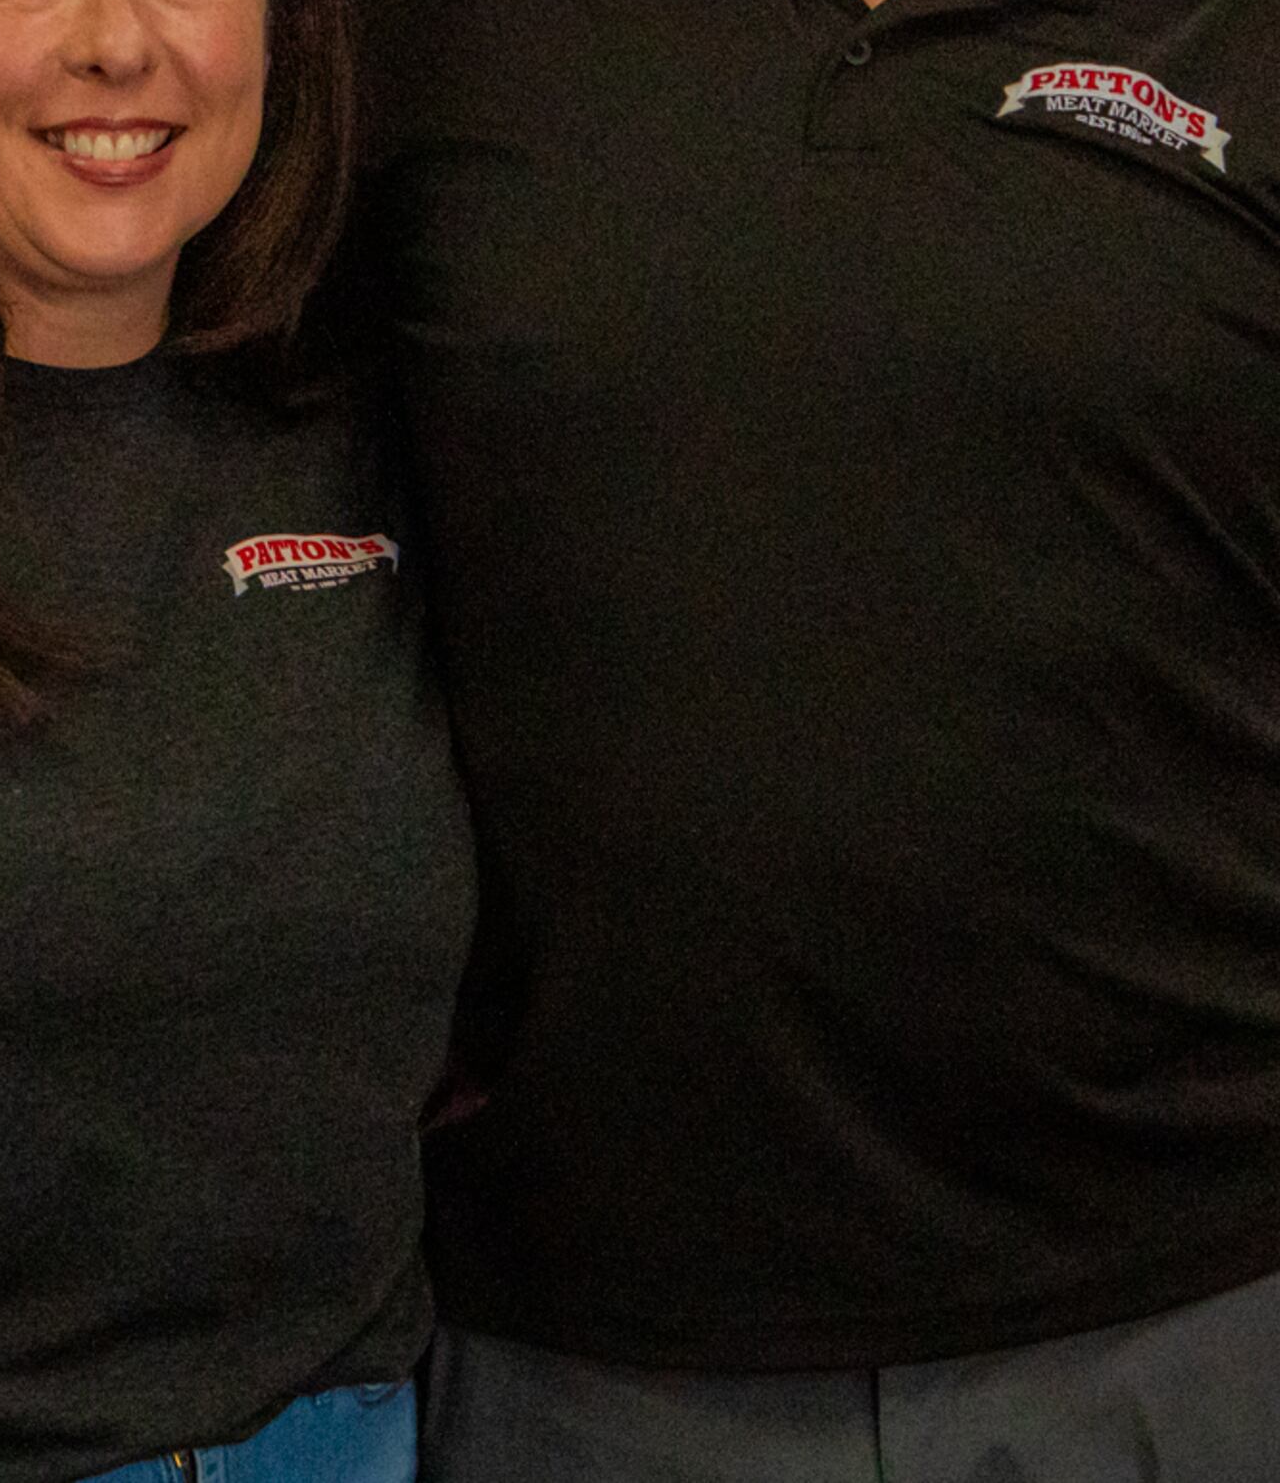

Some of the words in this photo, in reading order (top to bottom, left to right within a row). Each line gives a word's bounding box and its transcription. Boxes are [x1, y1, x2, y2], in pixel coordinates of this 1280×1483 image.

[1026, 69, 1208, 139] PATTON'S
[1045, 95, 1107, 114] MEAT
[1108, 100, 1189, 151] MARKET
[235, 538, 385, 573] PATTON'S
[258, 568, 299, 589] MEAT
[299, 559, 378, 581] MARKET
